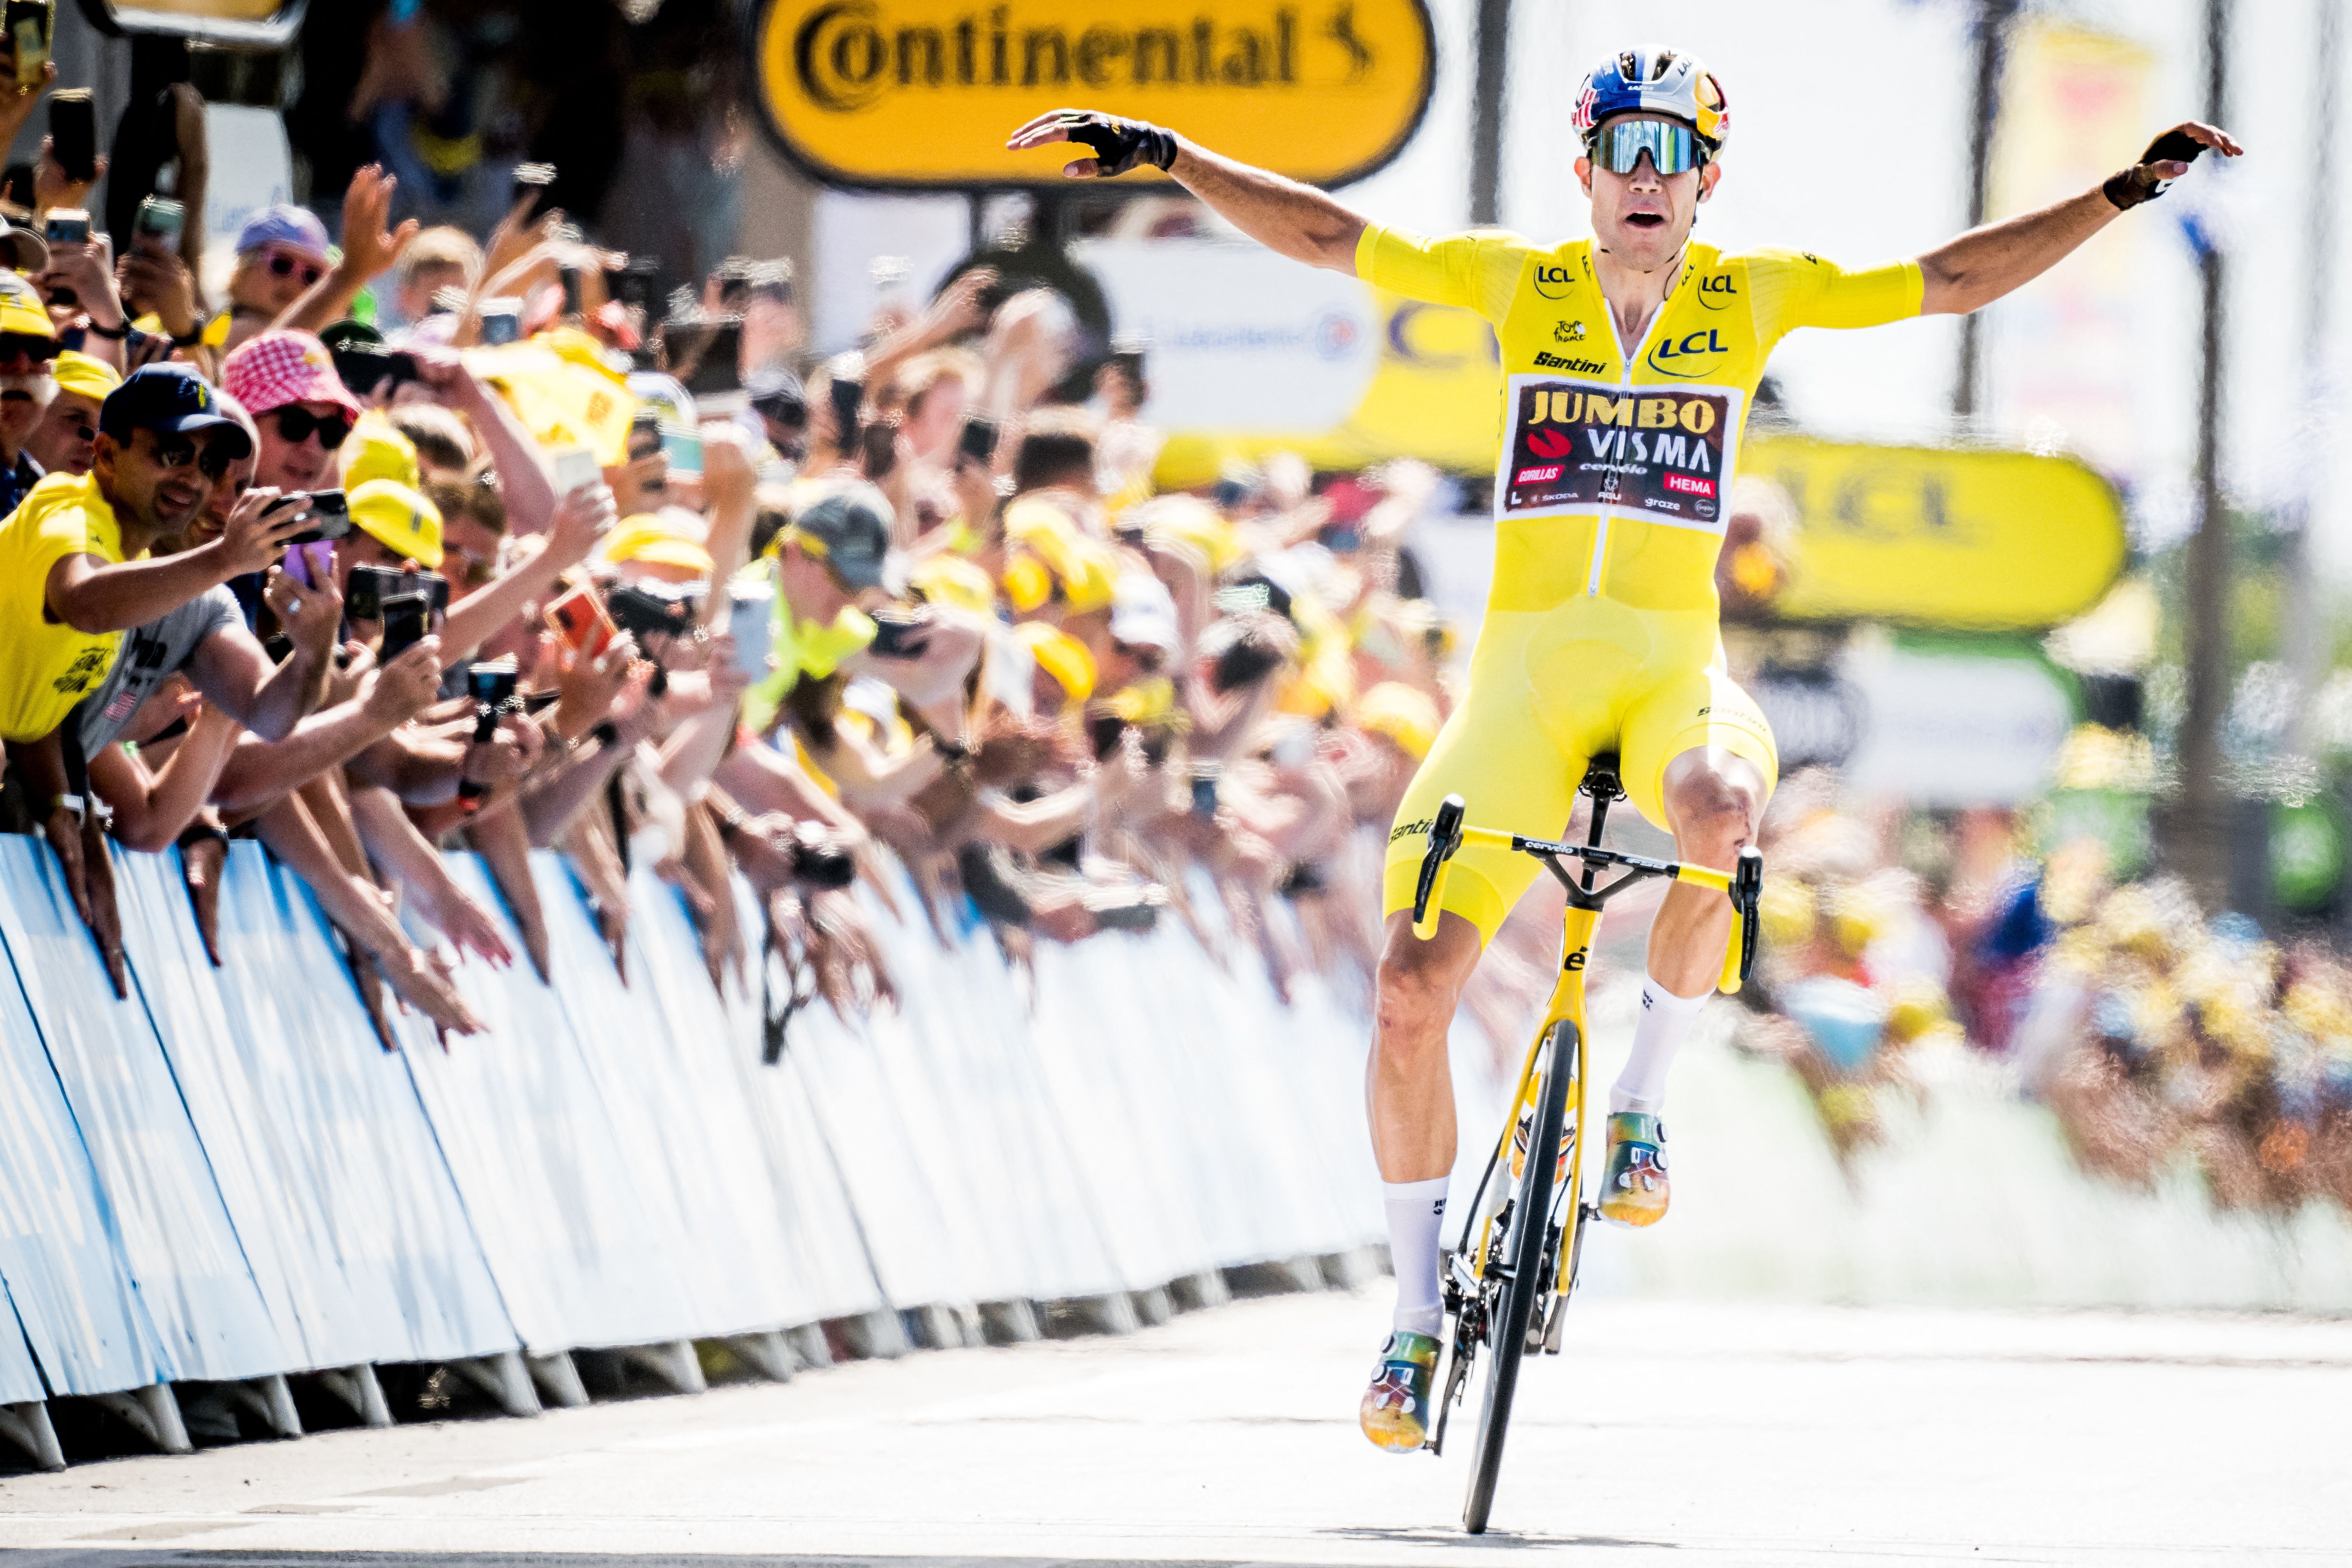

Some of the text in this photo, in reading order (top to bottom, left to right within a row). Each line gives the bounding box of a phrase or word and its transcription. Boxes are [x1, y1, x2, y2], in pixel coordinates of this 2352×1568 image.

[792, 2, 1296, 112] Continental
[1538, 266, 1576, 283] LCL
[1702, 275, 1738, 294] LCL
[1658, 329, 1729, 359] LCL
[1533, 351, 1608, 374] Santini
[1528, 390, 1716, 434] JUMBO
[1587, 428, 1710, 474] VISMA
[1518, 467, 1559, 482] GORILLAS
[1670, 475, 1711, 495] HEMA
[1644, 497, 1681, 511] graze
[1564, 945, 1588, 972] é
